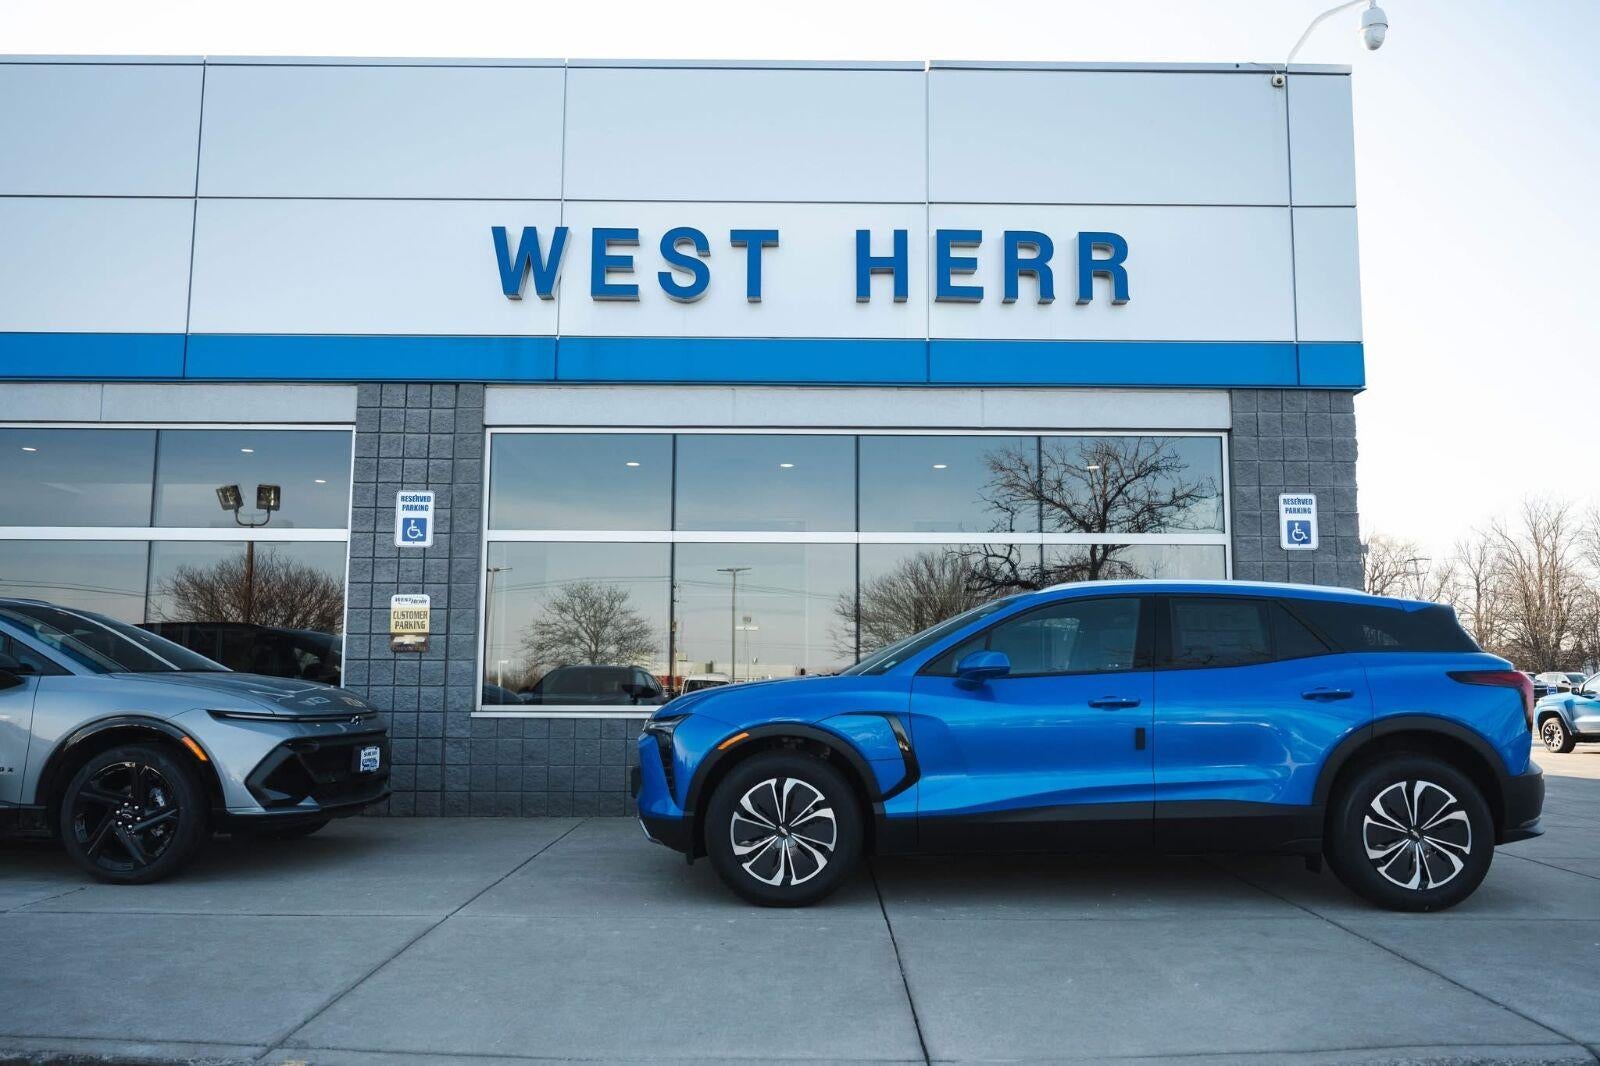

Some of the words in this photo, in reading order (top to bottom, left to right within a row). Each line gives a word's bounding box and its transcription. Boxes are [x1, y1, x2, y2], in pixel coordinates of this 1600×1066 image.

[491, 226, 779, 303] WEST
[856, 228, 1131, 305] HERR
[402, 504, 429, 512] PARKING
[393, 611, 428, 620] CUSTOMER
[394, 620, 426, 630] PARKING
